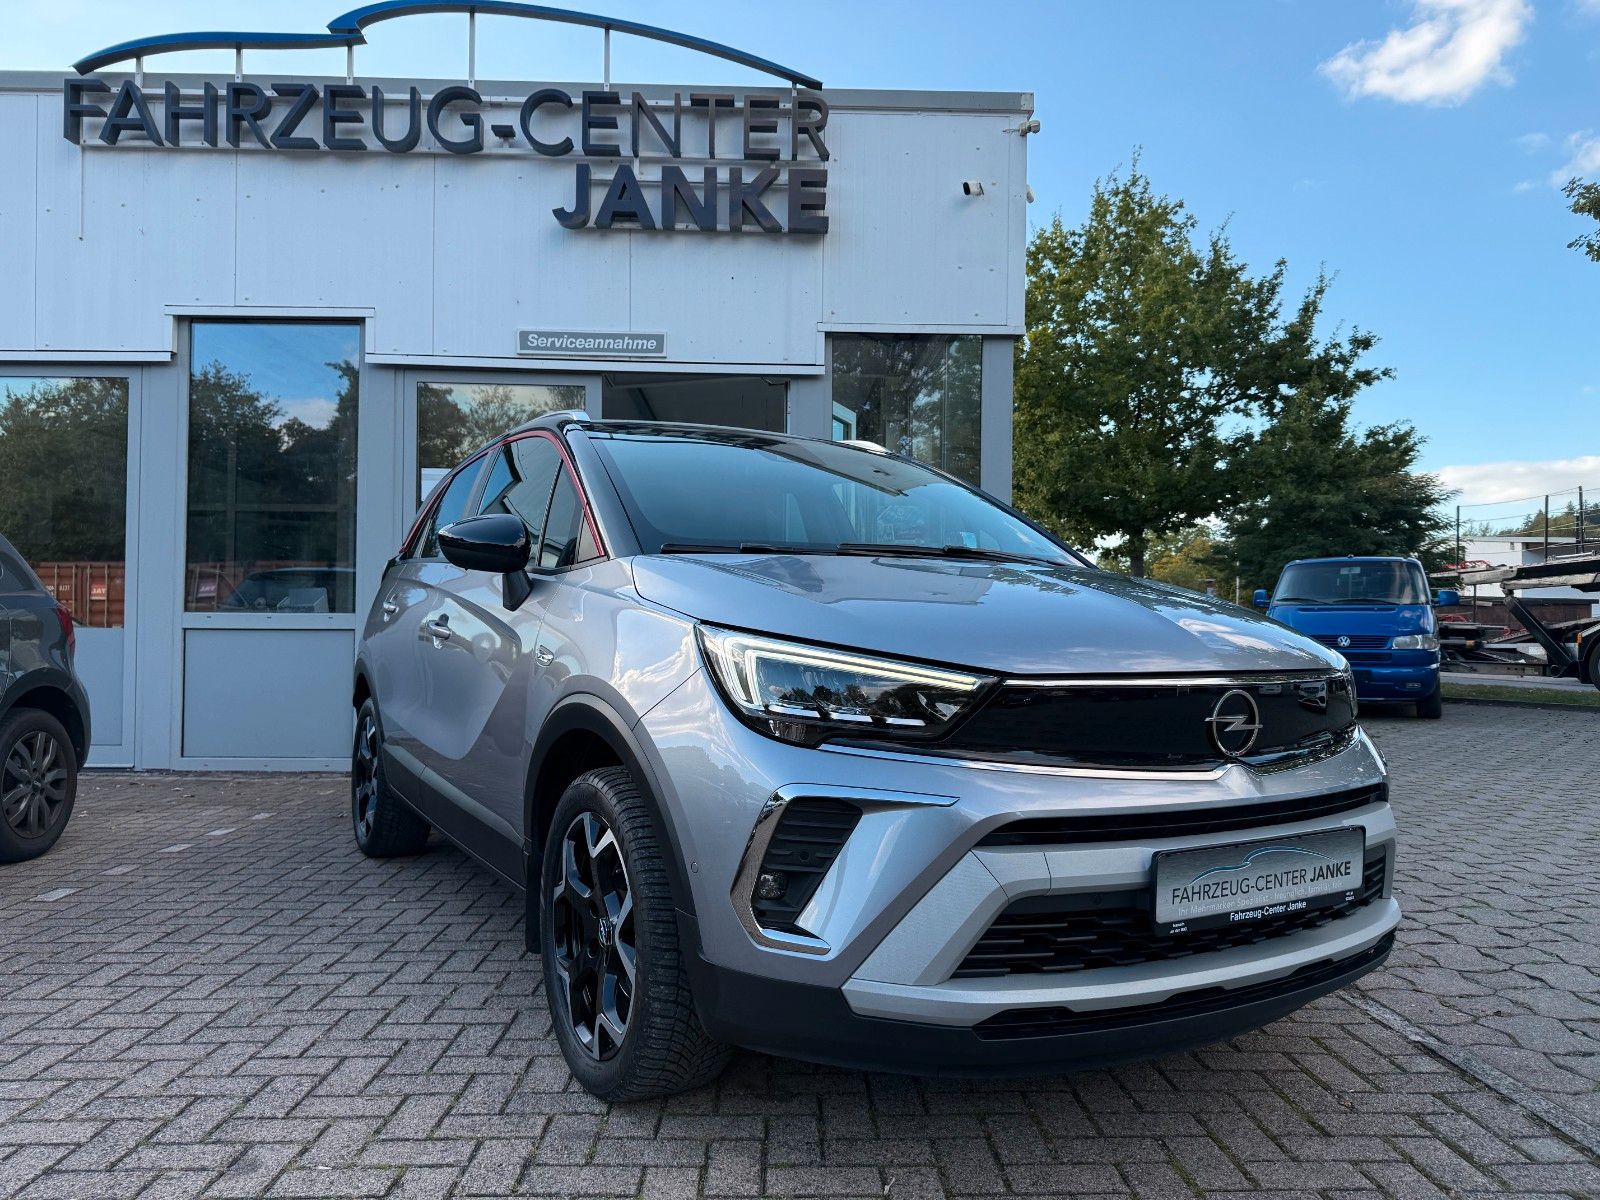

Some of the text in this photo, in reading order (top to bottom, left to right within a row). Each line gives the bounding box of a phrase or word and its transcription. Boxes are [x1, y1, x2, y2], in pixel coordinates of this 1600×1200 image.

[64, 78, 829, 162] FAHRZEUG-CENTER
[552, 163, 829, 234] JANKE
[527, 333, 657, 350] Serviceannahme
[1172, 861, 1351, 905] FAHRZEUG-CENTER JANKE
[1230, 900, 1307, 922] Fahrzeug-Center Janke
